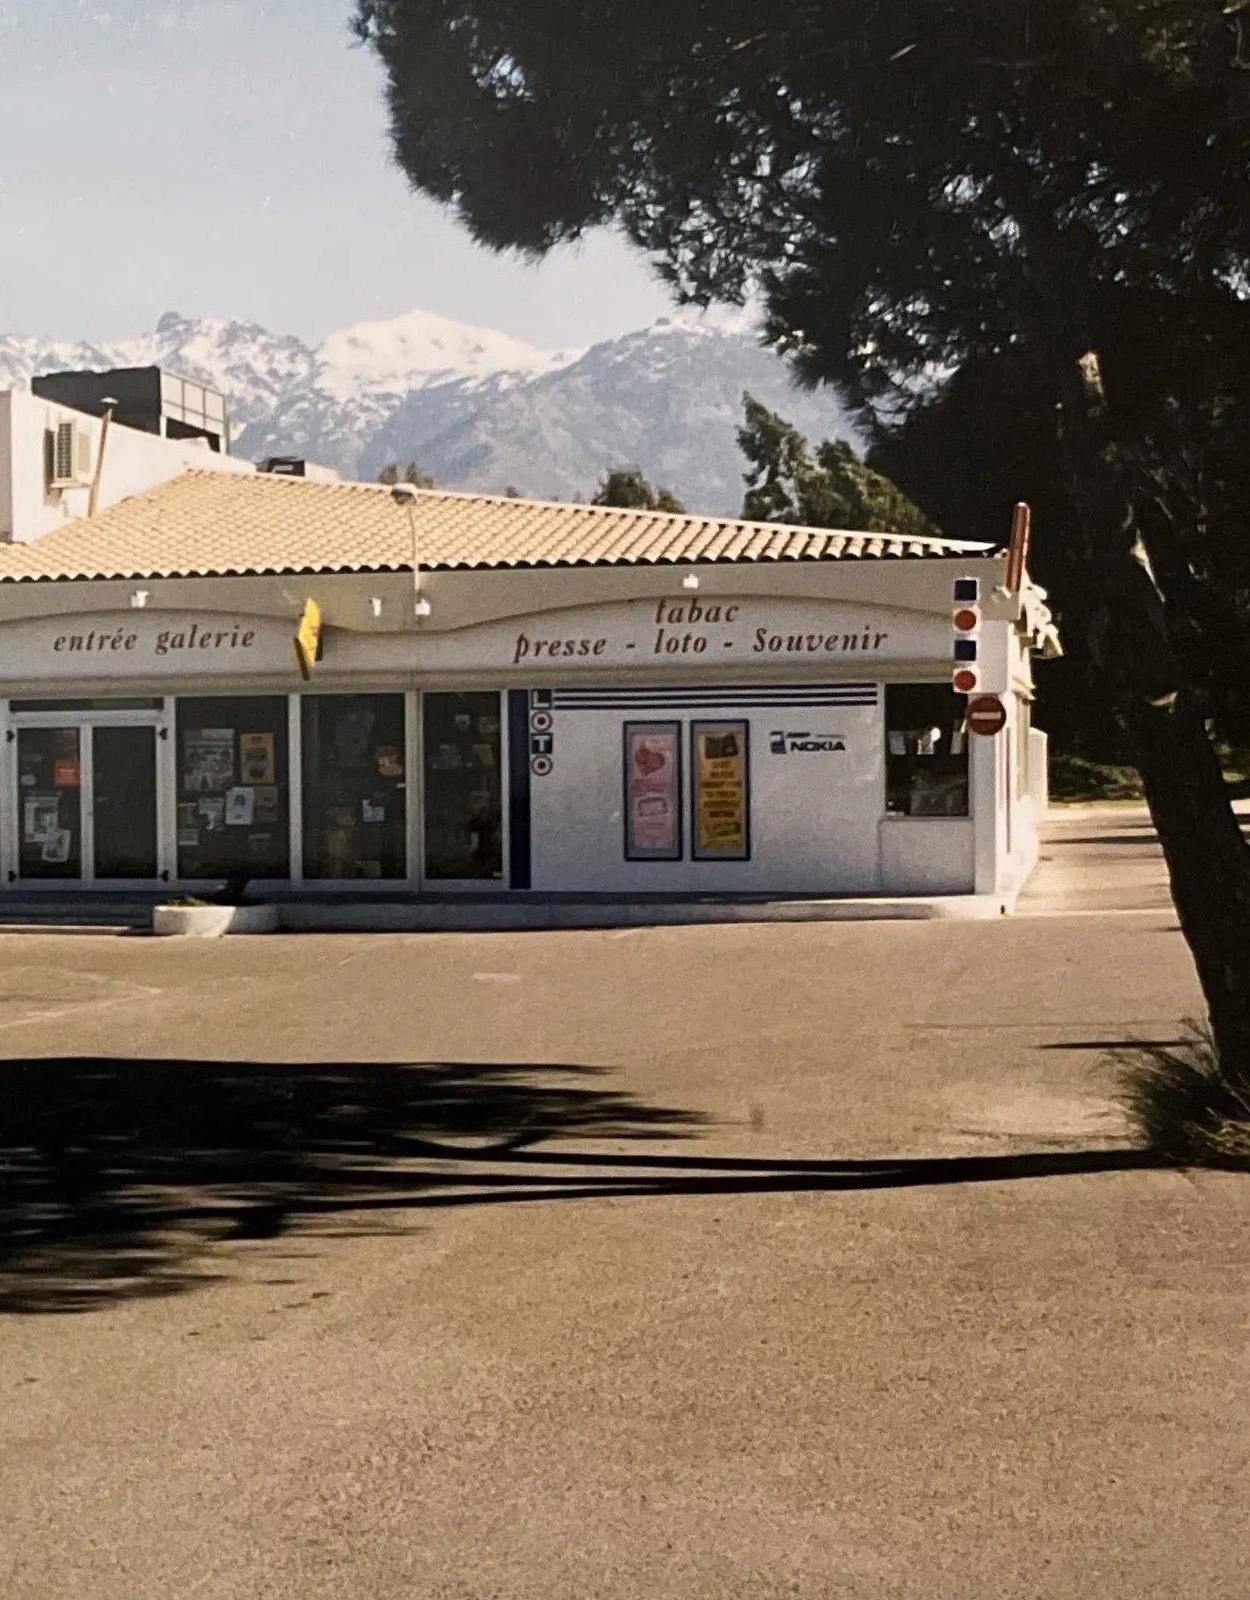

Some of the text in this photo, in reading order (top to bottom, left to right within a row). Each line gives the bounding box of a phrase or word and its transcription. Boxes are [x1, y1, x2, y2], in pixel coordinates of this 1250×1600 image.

[655, 597, 740, 624] tabac
[53, 624, 255, 655] entrée galerie
[513, 632, 607, 664] presse
[654, 628, 708, 654] loto
[752, 625, 889, 652] Souvenir
[789, 740, 847, 752] NOKIA
